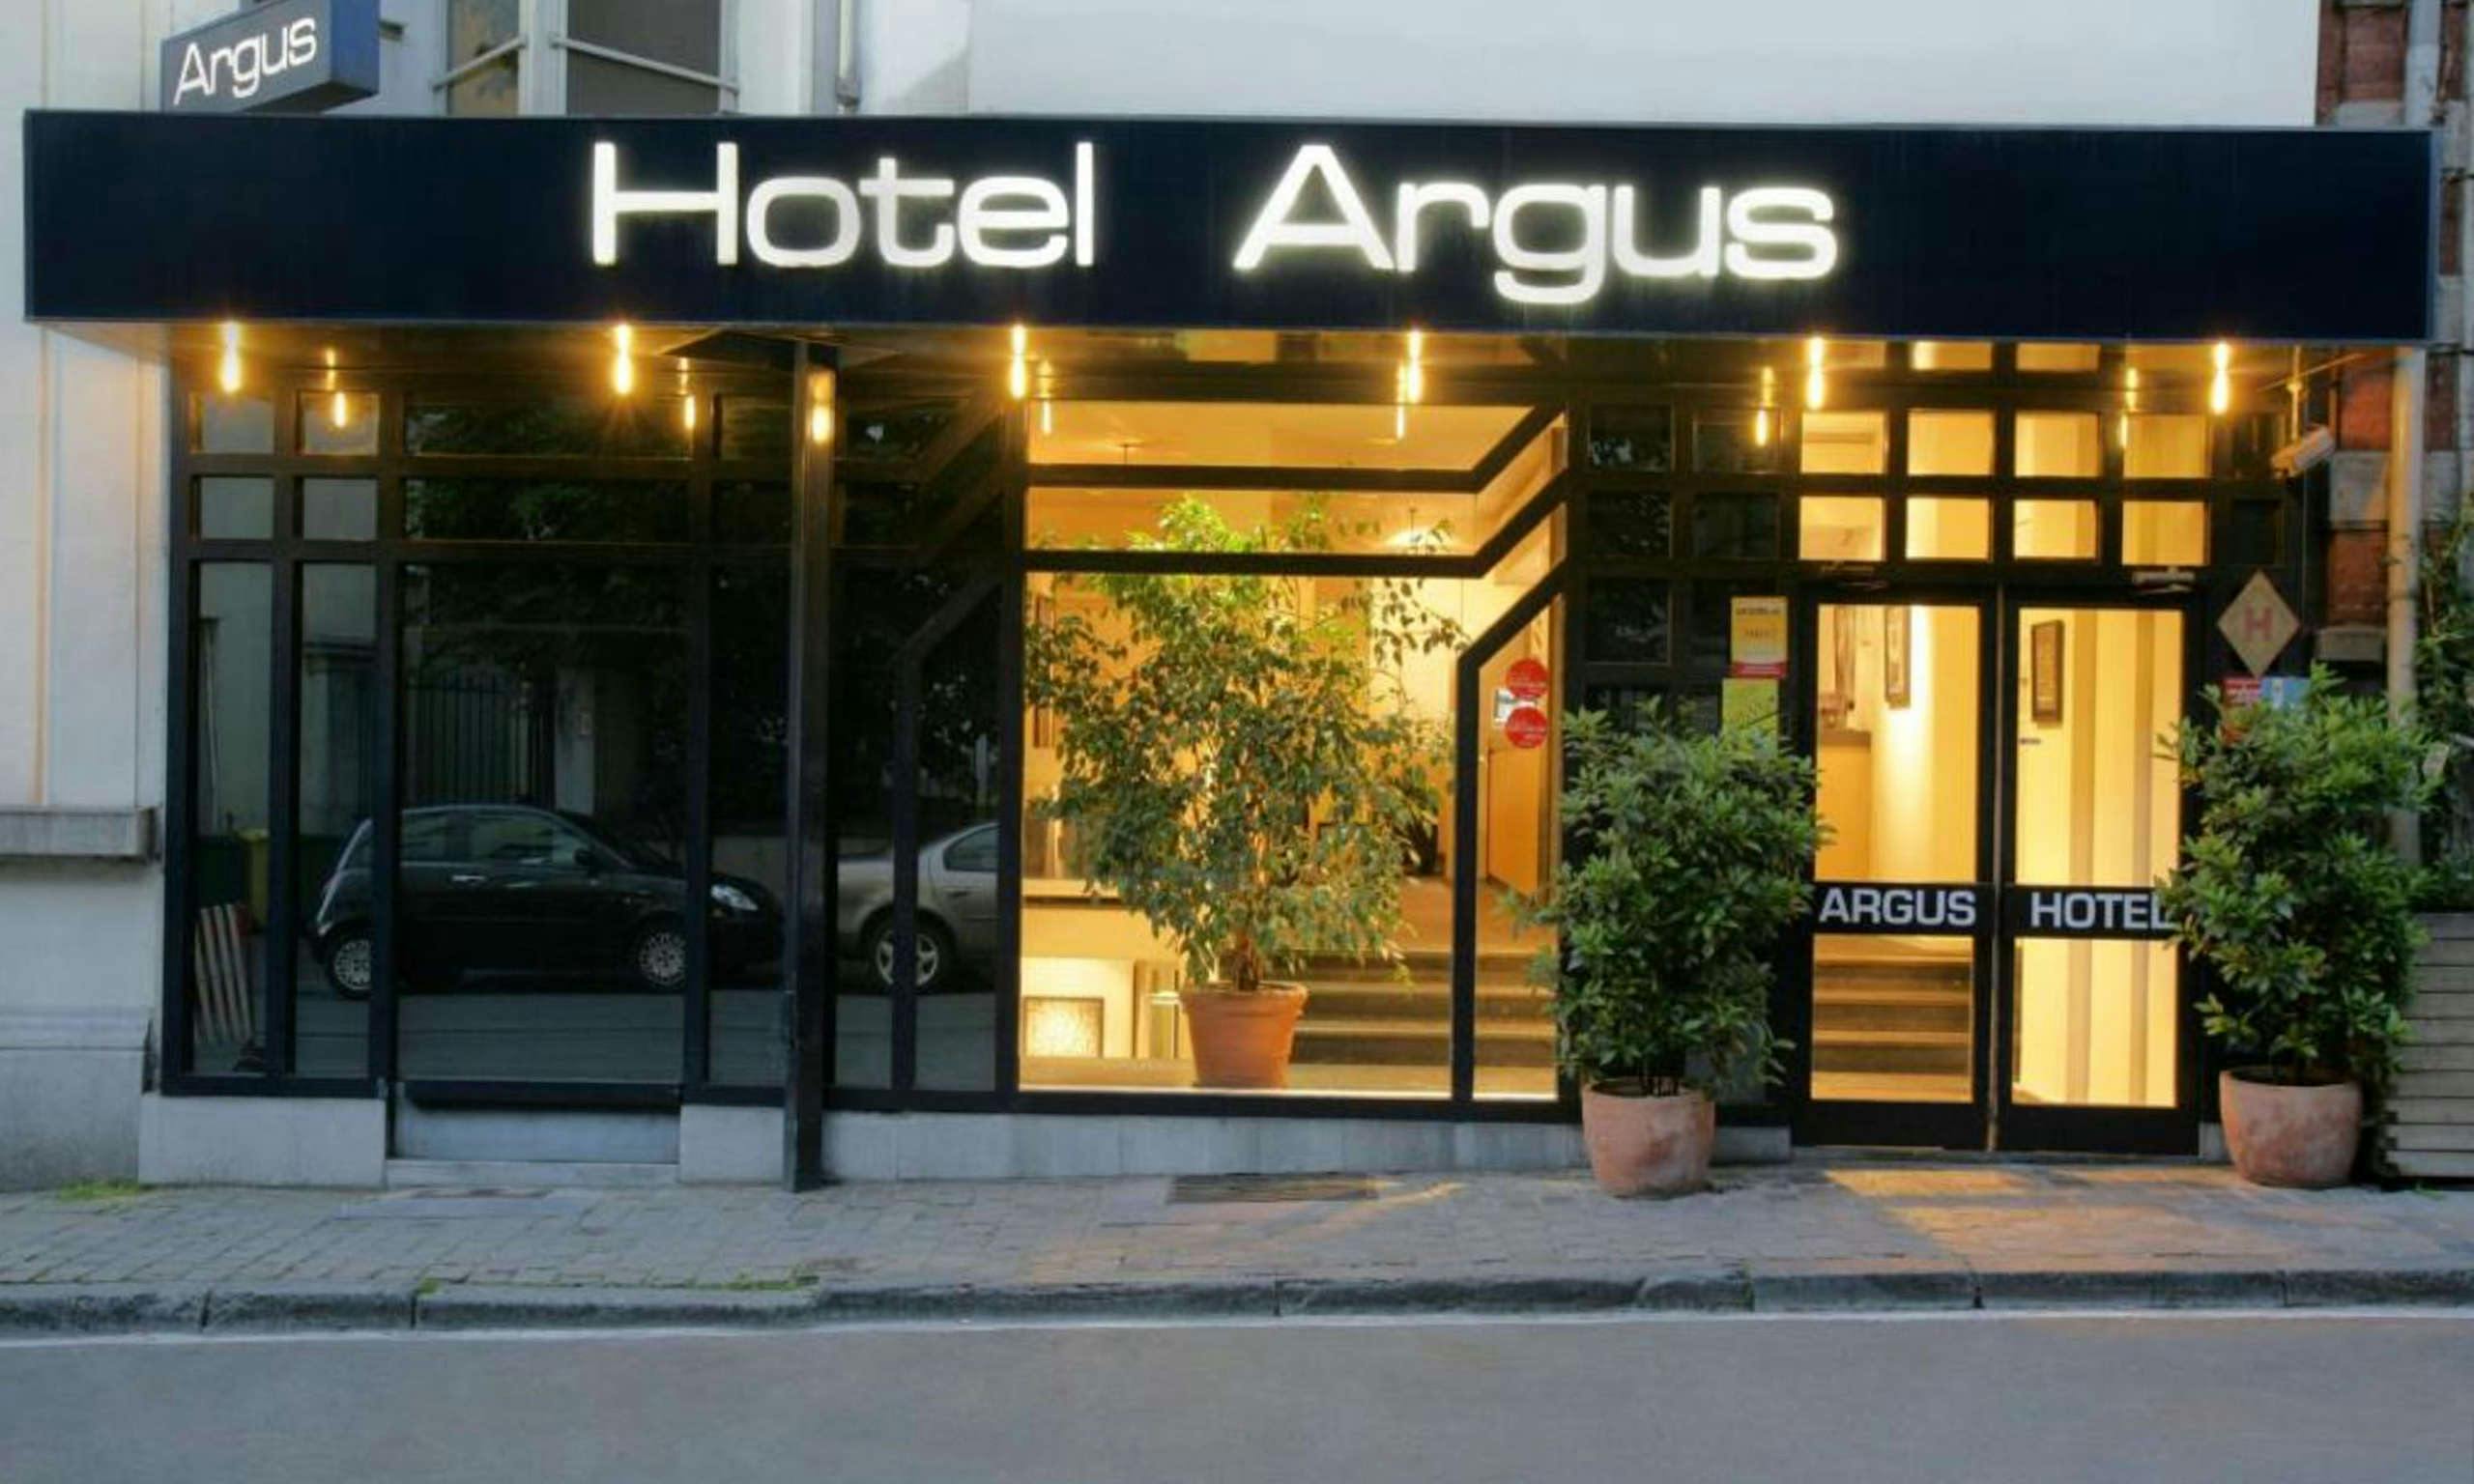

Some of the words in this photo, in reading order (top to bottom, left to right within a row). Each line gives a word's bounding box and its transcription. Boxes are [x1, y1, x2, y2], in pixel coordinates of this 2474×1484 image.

[173, 16, 317, 106] Argus
[592, 141, 1094, 268] Hotel
[1232, 144, 1838, 305] Argus
[2243, 603, 2274, 642] H
[1819, 888, 1977, 926] ARGUS
[2030, 892, 2172, 930] HOTEL
